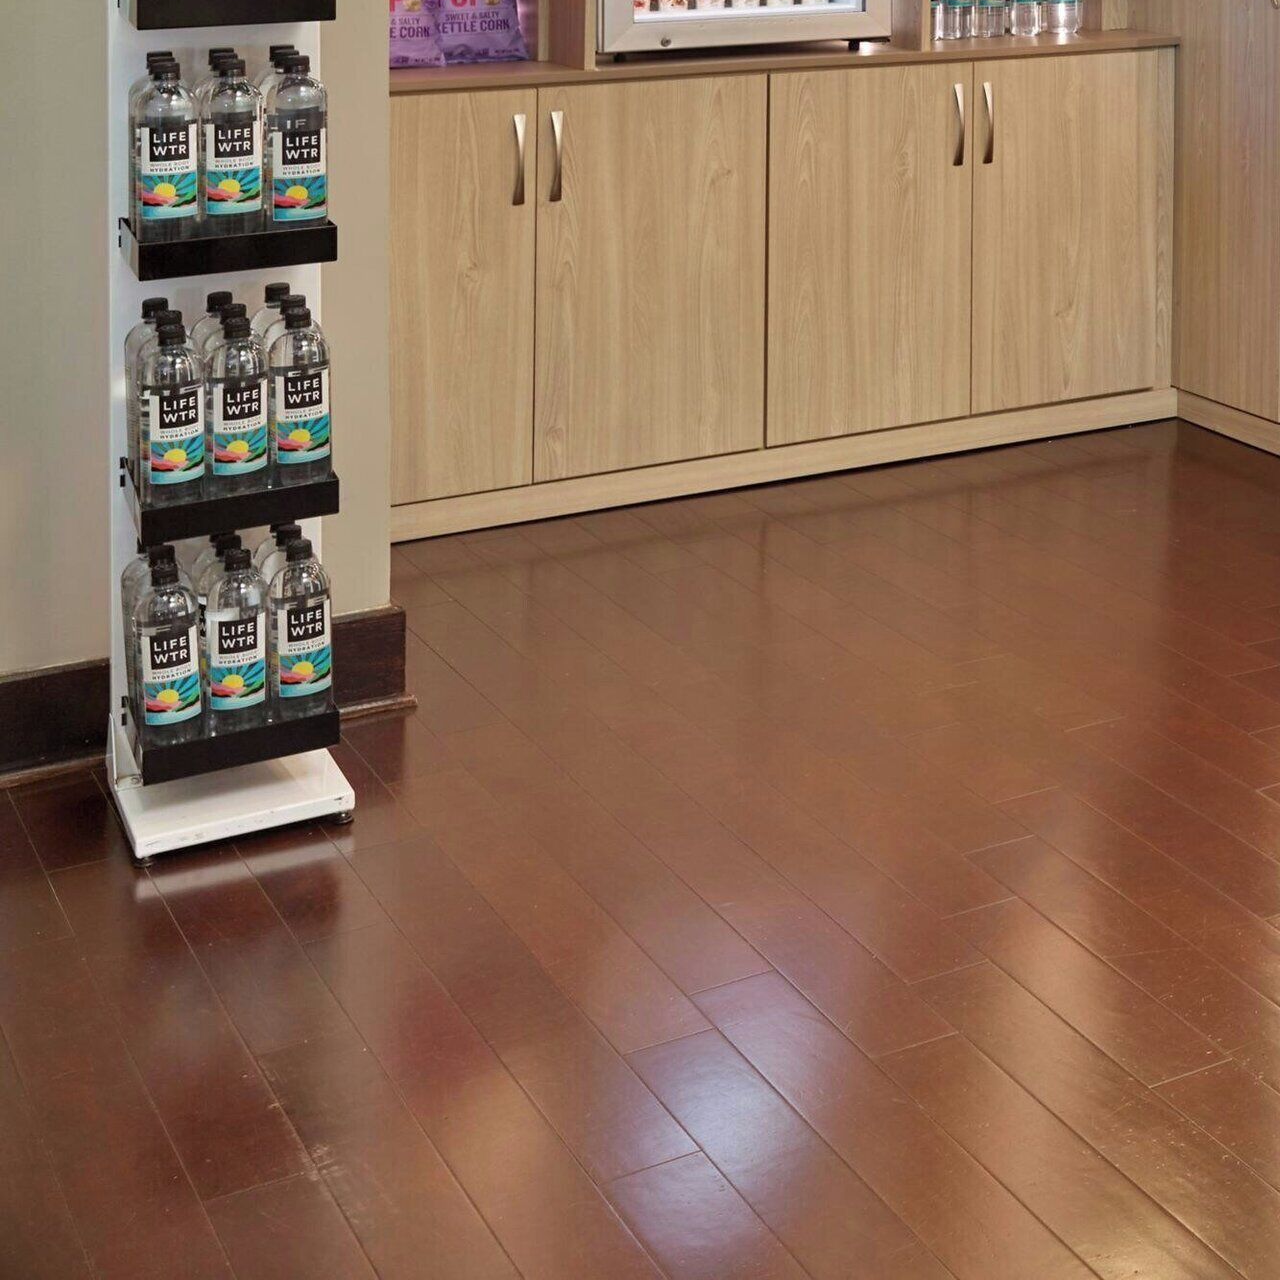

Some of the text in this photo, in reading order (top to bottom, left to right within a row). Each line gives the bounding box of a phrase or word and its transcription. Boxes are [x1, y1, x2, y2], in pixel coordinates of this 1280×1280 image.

[480, 19, 510, 31] CORN
[400, 26, 430, 38] CORN
[153, 132, 186, 143] LIFE
[219, 128, 250, 140] LIFE
[218, 141, 250, 152] WTR
[286, 136, 318, 147] LIFE
[153, 145, 187, 156] WTR
[286, 148, 318, 159] WTR
[288, 379, 319, 392] LIFE
[227, 389, 259, 403] LIFE
[288, 392, 320, 404] WTR
[163, 397, 196, 410] LIFE
[227, 402, 259, 415] WTR
[163, 411, 196, 423] WTR
[291, 608, 322, 624] LIFE
[222, 622, 254, 636] LIFE
[291, 623, 322, 636] WTR
[154, 636, 187, 651] LIFE
[222, 636, 254, 648] WTR
[154, 650, 187, 664] WTR
